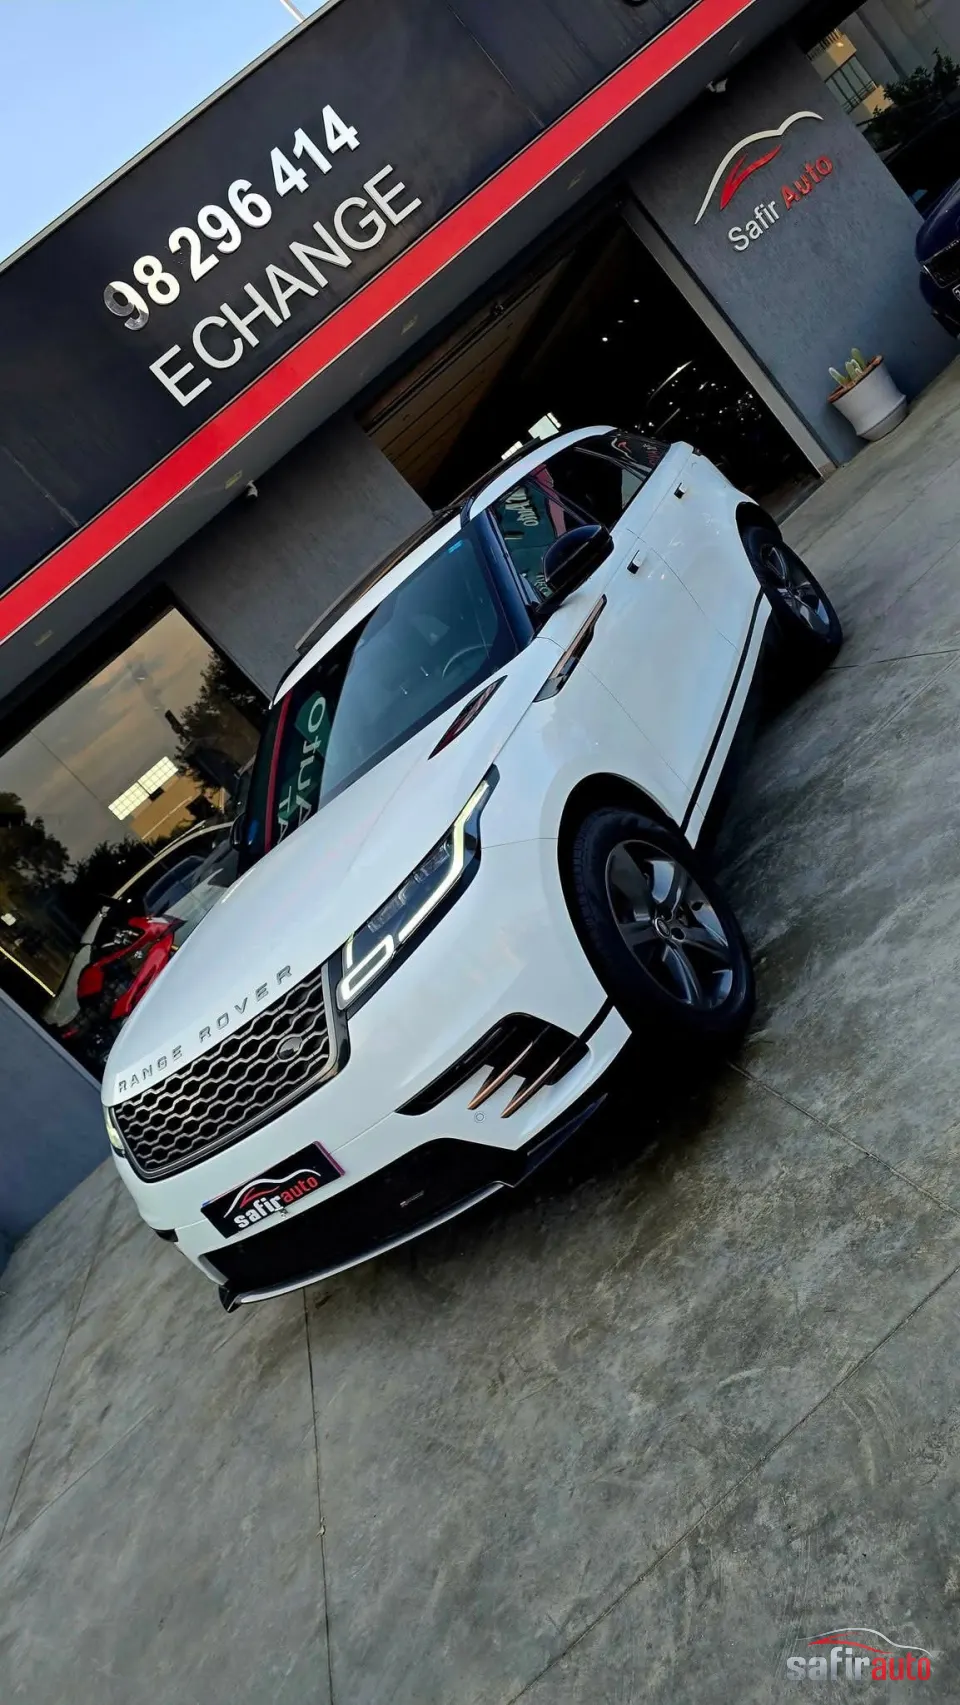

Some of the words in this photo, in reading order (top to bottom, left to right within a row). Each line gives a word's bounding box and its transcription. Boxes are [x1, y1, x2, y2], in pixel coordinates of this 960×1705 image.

[103, 255, 181, 331] 98
[168, 178, 273, 282] 296
[270, 104, 360, 197] 414
[148, 163, 423, 408] ECHANGE
[727, 201, 780, 251] Safir
[780, 155, 833, 209] Auto
[118, 1045, 183, 1093] RANGE
[198, 965, 292, 1043] ROVER
